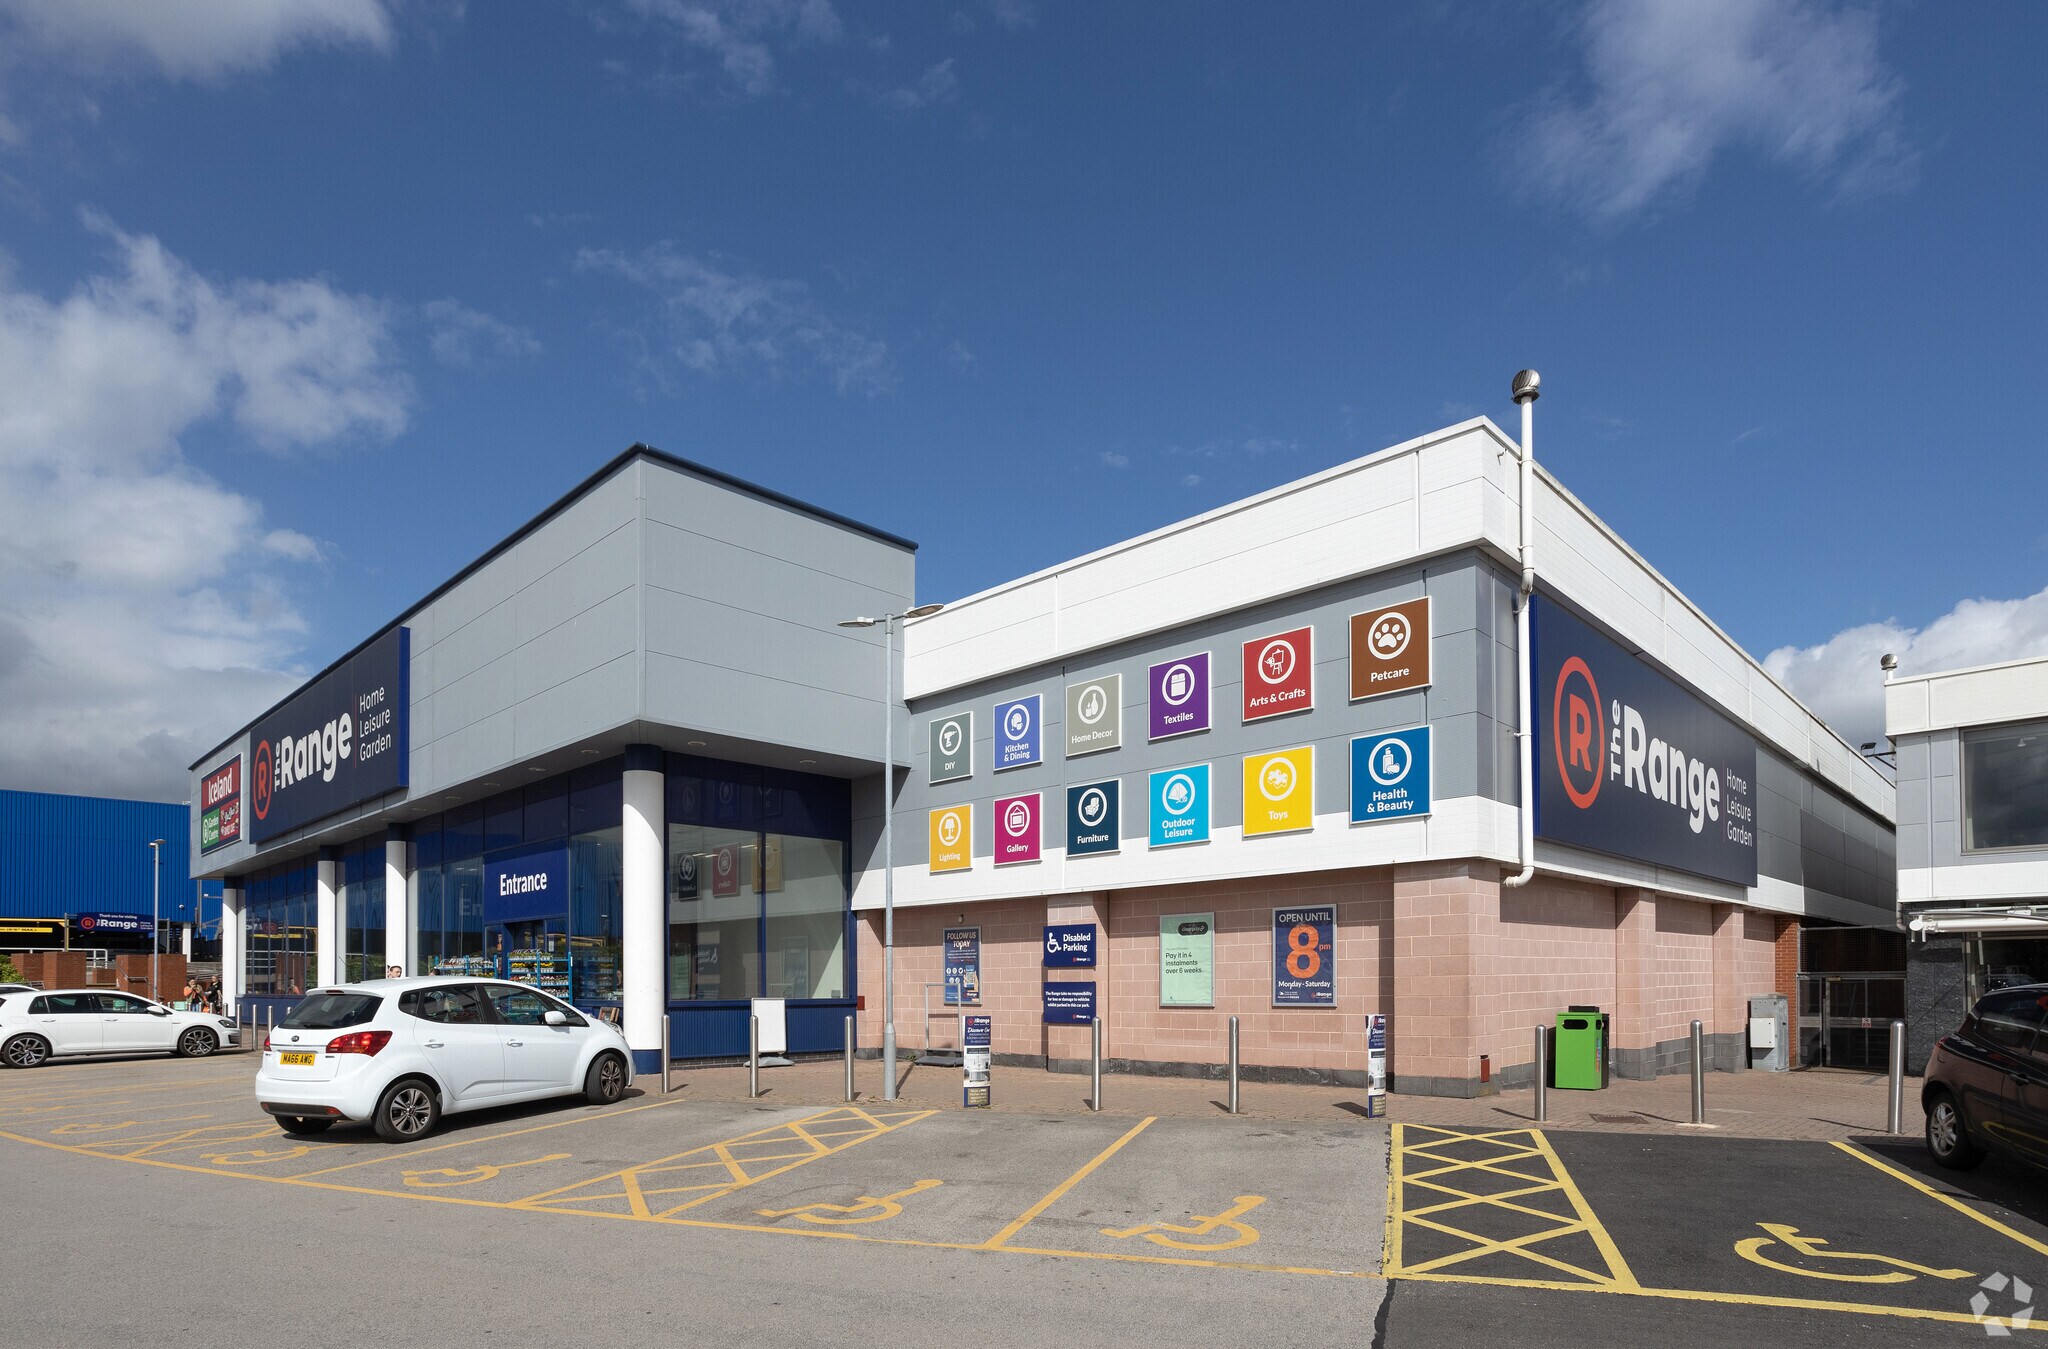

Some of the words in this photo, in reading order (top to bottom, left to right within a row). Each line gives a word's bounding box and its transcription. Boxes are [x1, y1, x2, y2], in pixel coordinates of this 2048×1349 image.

[1370, 666, 1410, 682] Petcare
[359, 686, 385, 714] Home
[1250, 695, 1269, 708] Arts
[1269, 693, 1277, 702] &
[1278, 688, 1306, 701] Crafts
[359, 708, 391, 738] Leisure
[1163, 712, 1194, 724] Textiles
[1071, 733, 1091, 744] Home
[1093, 729, 1113, 741] Decor
[281, 712, 353, 789] Range
[359, 733, 391, 762] Garden
[1005, 742, 1029, 754] Kitchen
[1004, 753, 1010, 762] &
[1010, 750, 1030, 762] Dining
[944, 761, 956, 771] DIY
[1610, 699, 1621, 781] The
[1624, 704, 1720, 834] Range
[208, 768, 232, 805] Iceland
[1726, 768, 1747, 795] Home
[1372, 788, 1408, 802] Health
[1367, 803, 1375, 813] &
[1376, 799, 1414, 813] Beauty
[1726, 793, 1751, 822] Leisure
[1268, 809, 1288, 821] Toys
[1161, 817, 1195, 829] Outdoor
[1077, 833, 1109, 845] Furniture
[1164, 827, 1193, 839] Leisure
[1727, 822, 1753, 847] Garden
[1006, 843, 1029, 854] Gallery
[939, 852, 961, 862] Lighting
[500, 872, 547, 896] Entrance
[1279, 913, 1303, 922] OPEN
[1304, 912, 1331, 921] UNTIL
[101, 919, 138, 929] Range
[947, 932, 969, 940] FOLLOW
[1063, 932, 1091, 942] Disabled
[953, 940, 970, 948] TODAY
[1063, 943, 1088, 953] Parking
[1286, 923, 1320, 979] 8
[282, 1054, 298, 1064] MA66
